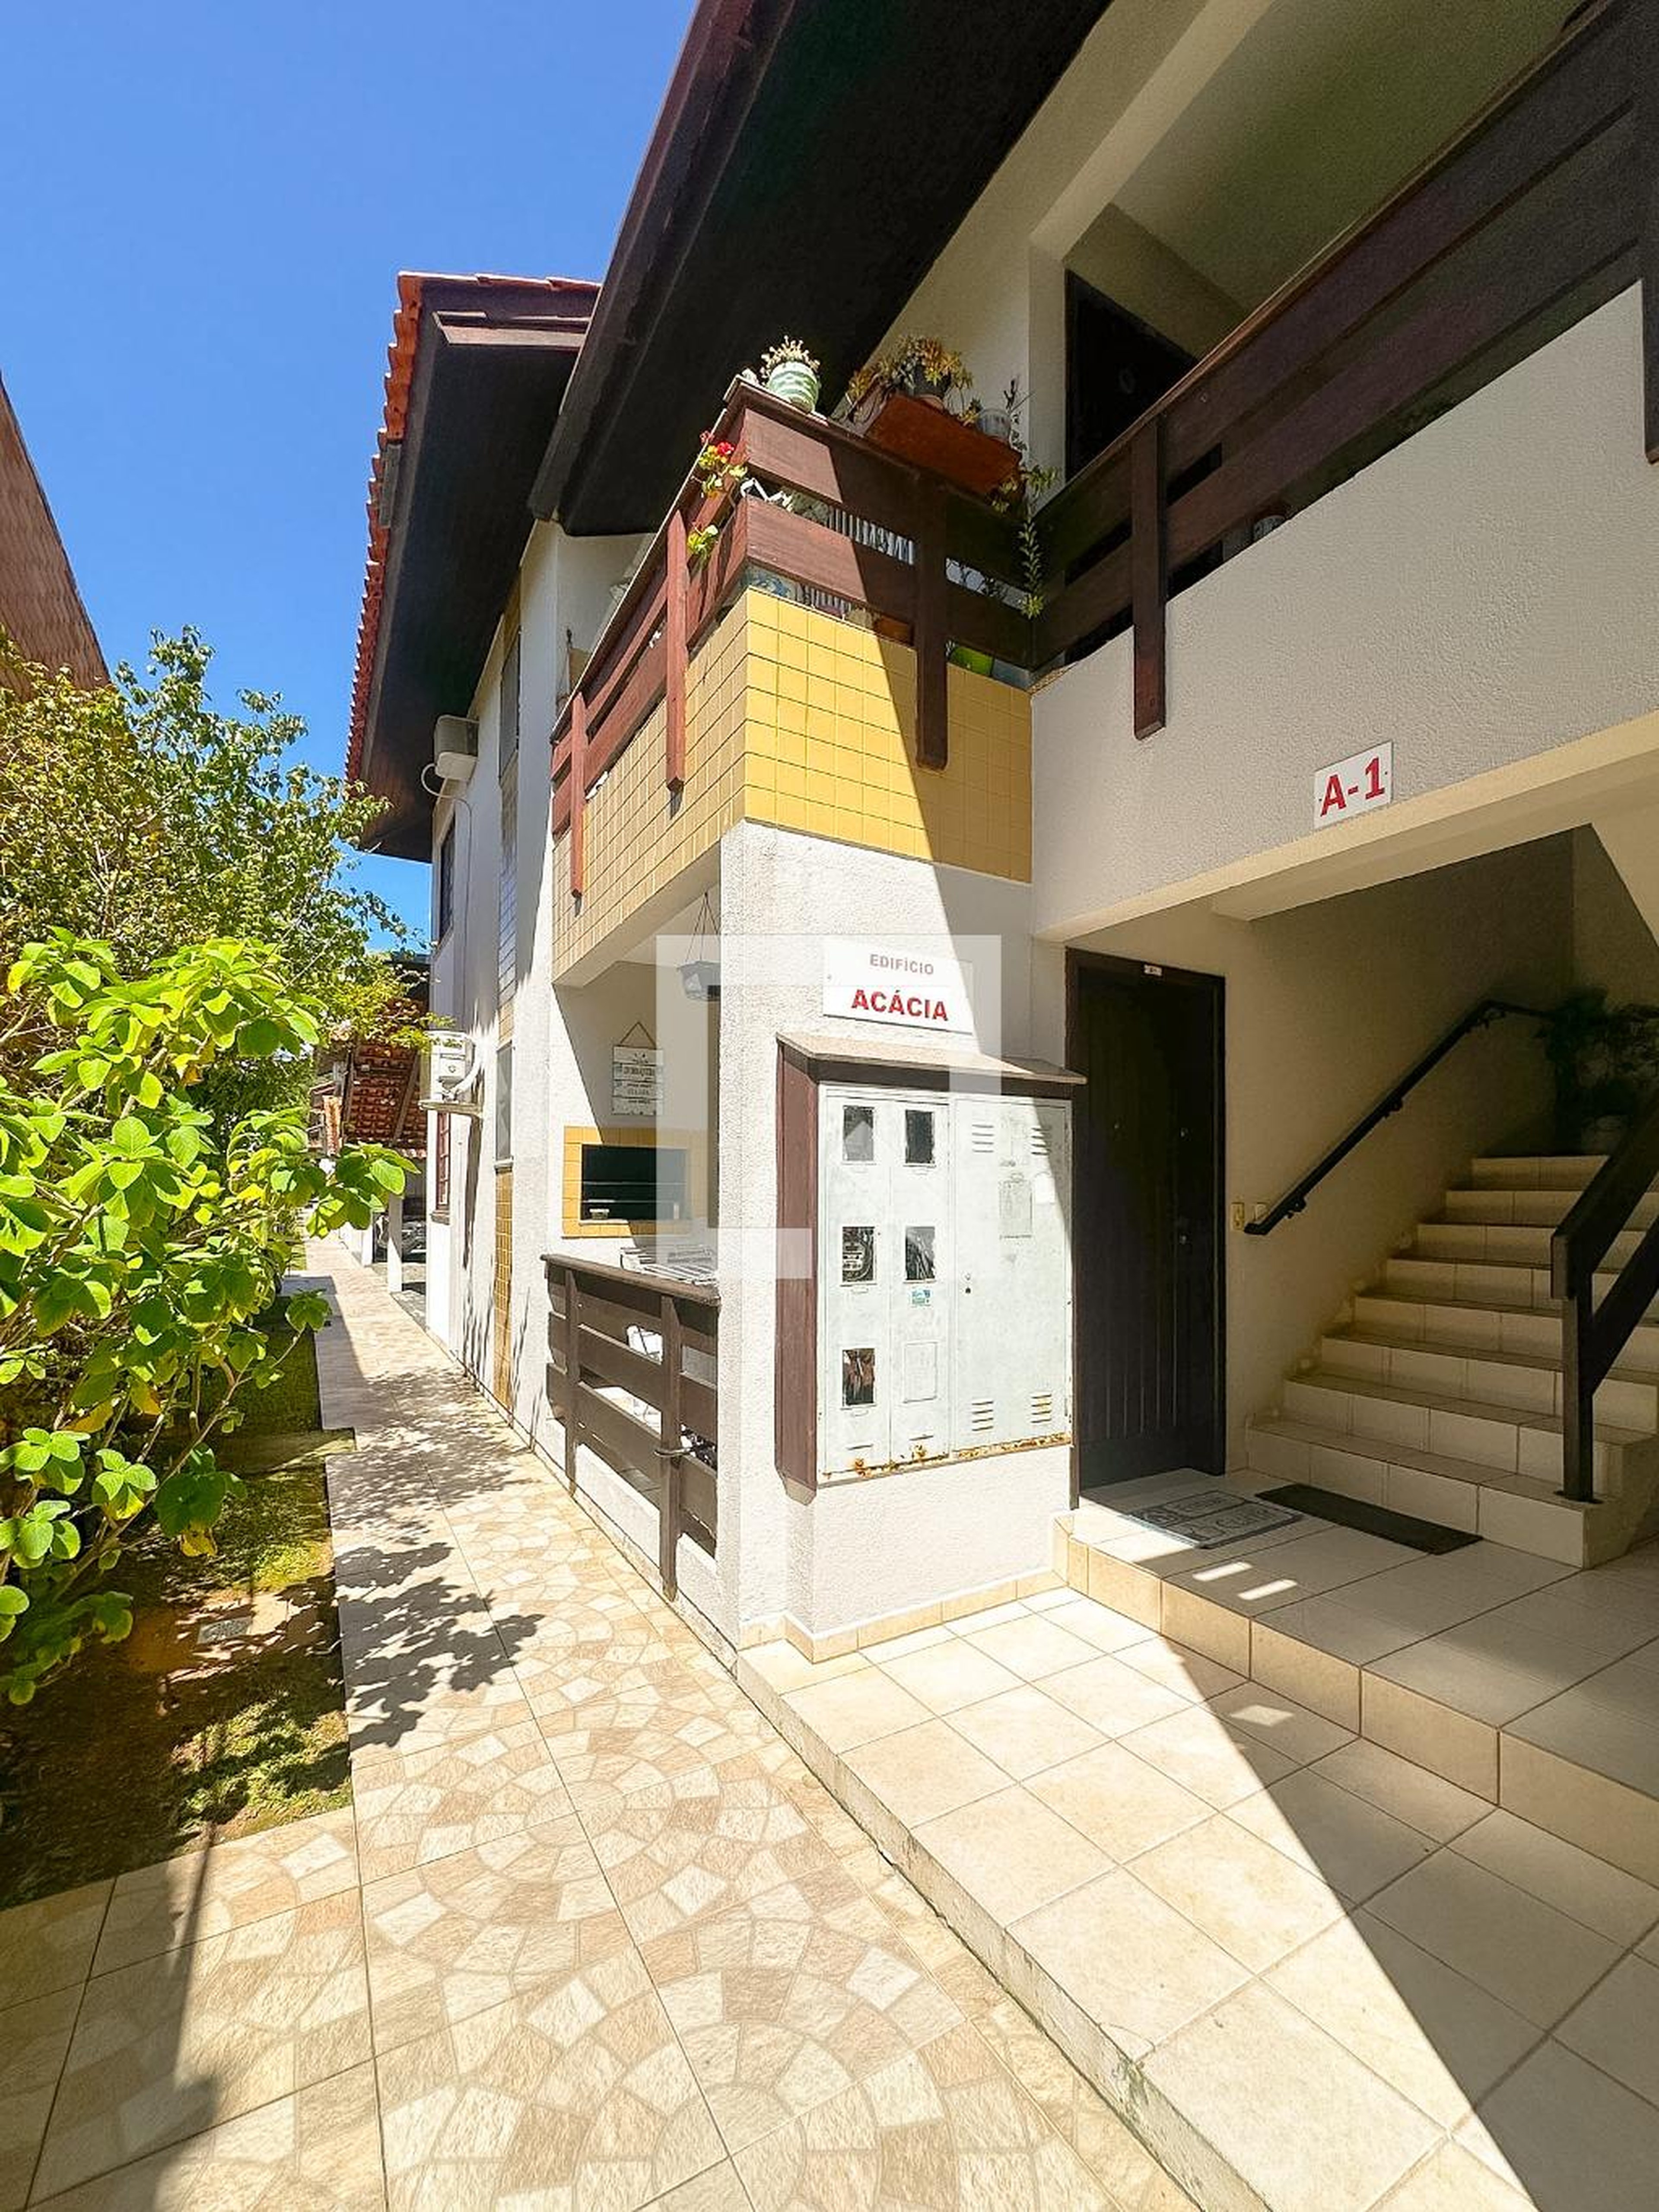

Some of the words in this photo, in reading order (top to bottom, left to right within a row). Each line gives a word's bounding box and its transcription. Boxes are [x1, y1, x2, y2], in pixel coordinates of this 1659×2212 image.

[1320, 757, 1385, 817] A-1
[870, 954, 934, 975] EDIFÍCIO
[851, 989, 948, 1021] ACÁCIA
